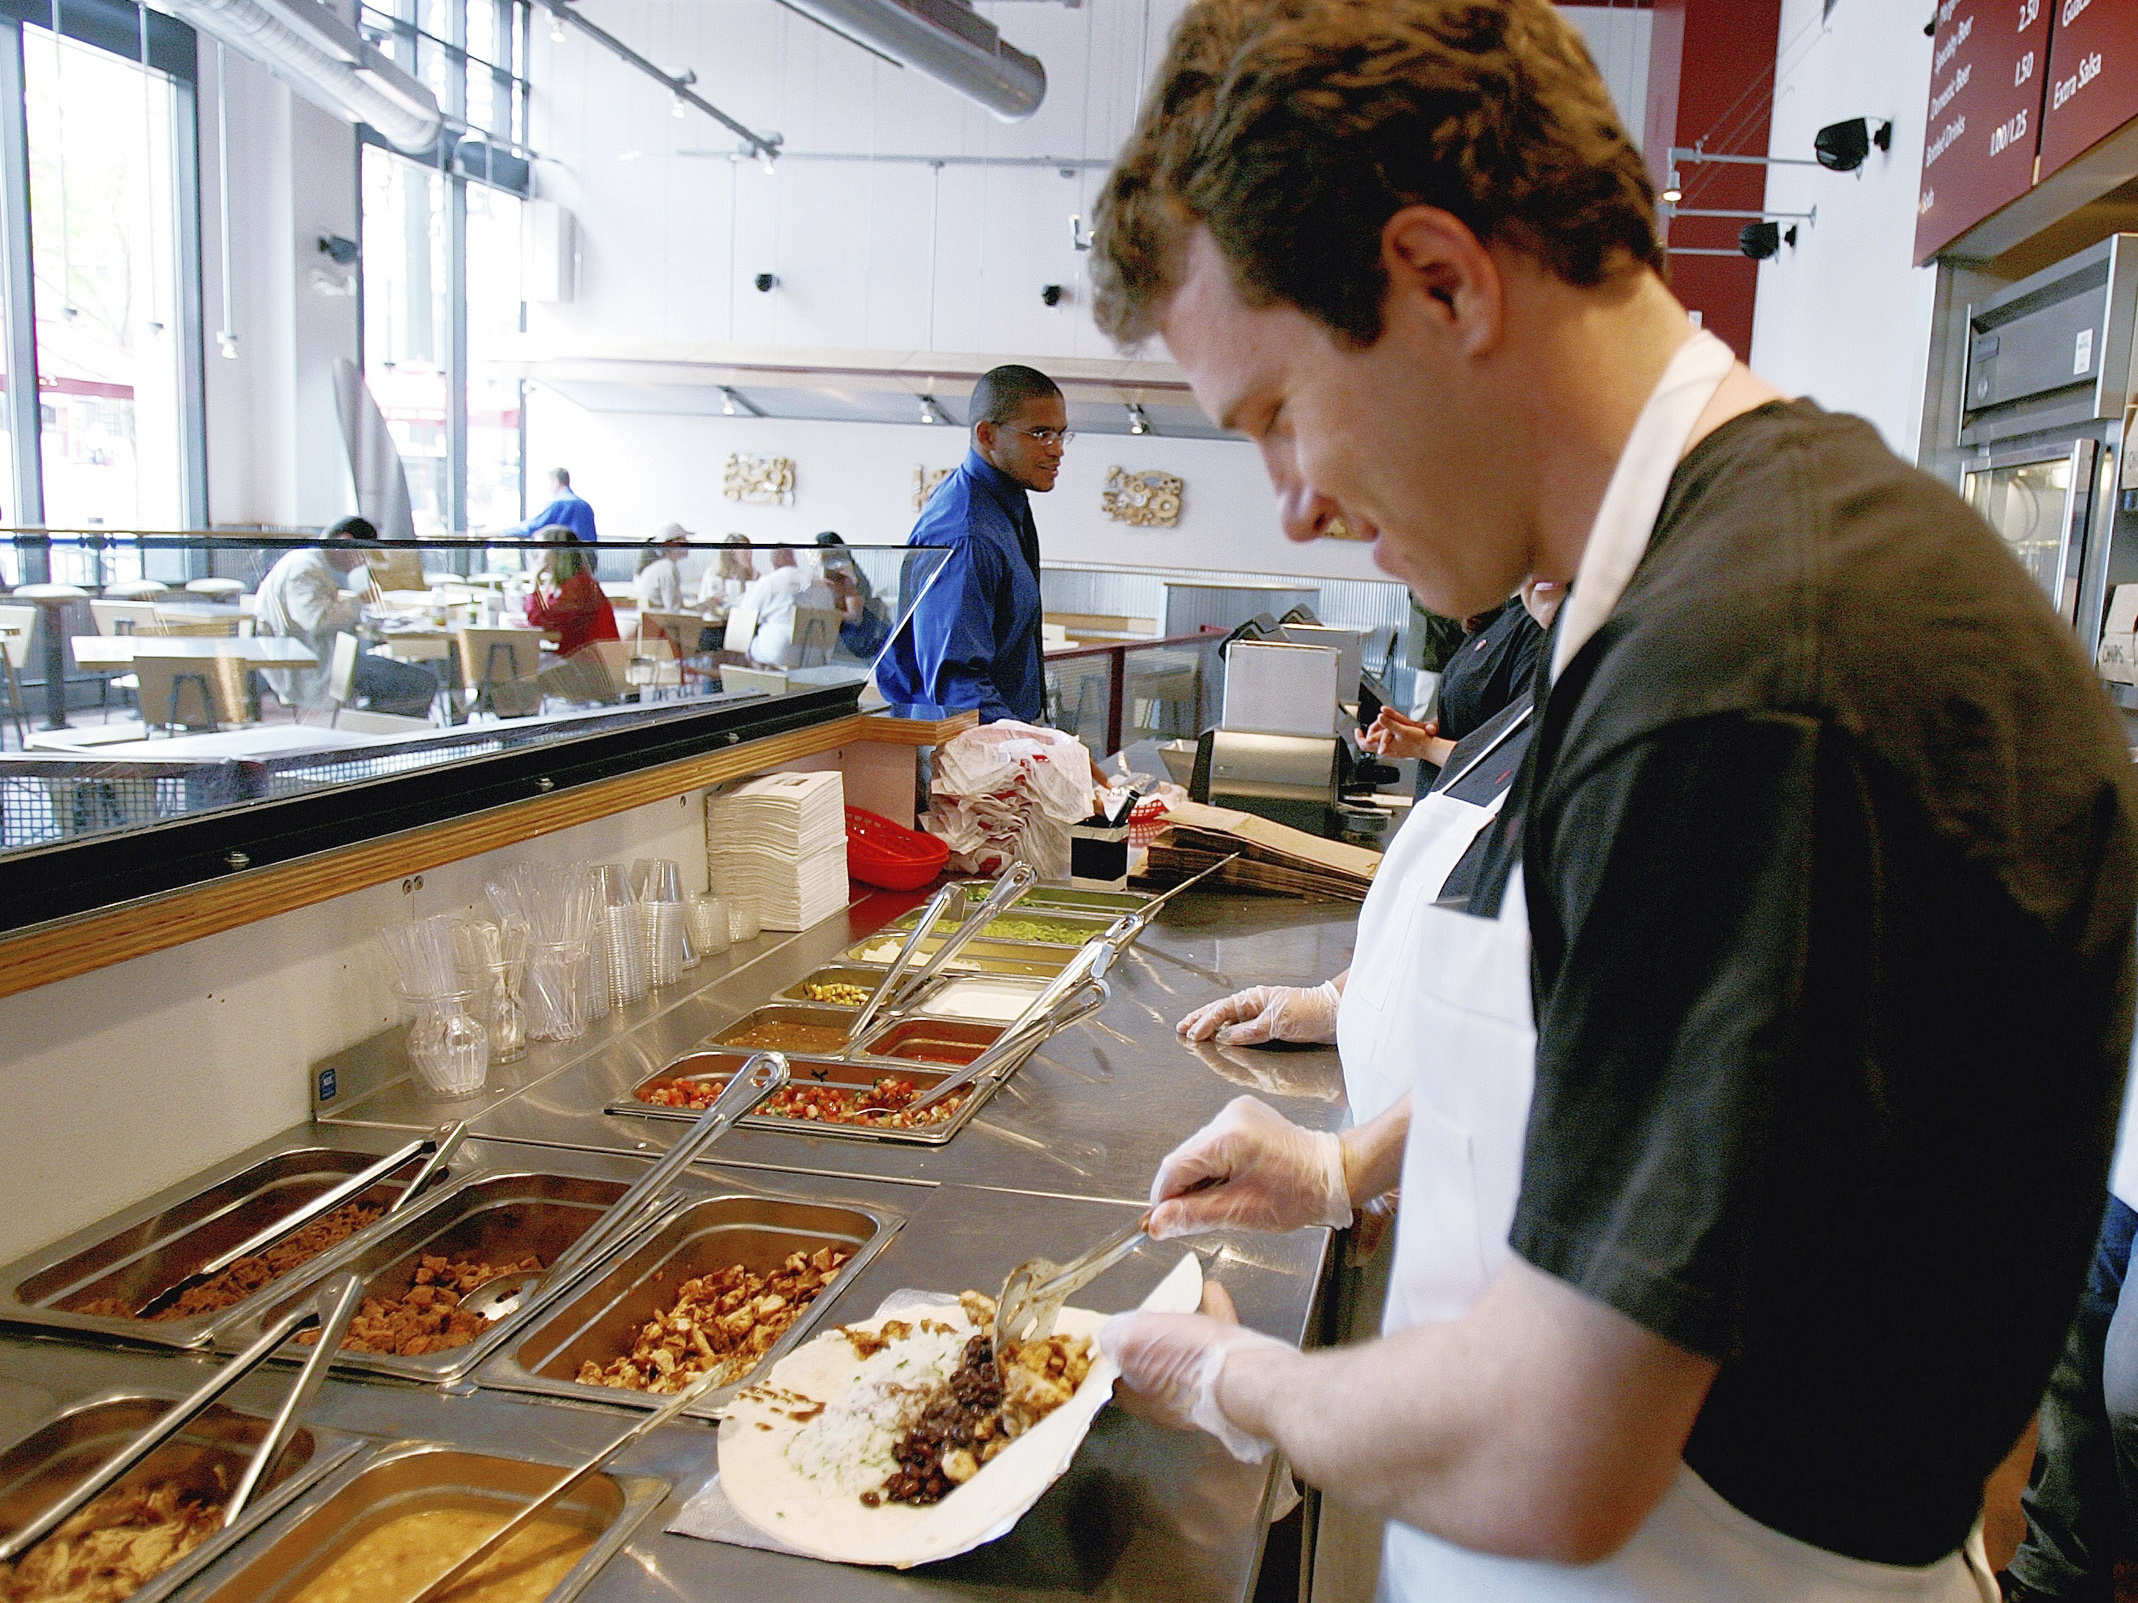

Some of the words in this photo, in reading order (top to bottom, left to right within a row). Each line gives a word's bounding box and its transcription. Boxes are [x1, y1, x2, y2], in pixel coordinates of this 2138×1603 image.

[1957, 15, 1974, 45] Beer
[1954, 63, 1972, 93] Beer
[2014, 51, 2034, 87] 1.50
[2053, 75, 2077, 110] Extra
[2077, 51, 2102, 89] Salsa
[1989, 108, 2028, 157] 1.00/1.25
[2102, 644, 2124, 664] CHIPS
